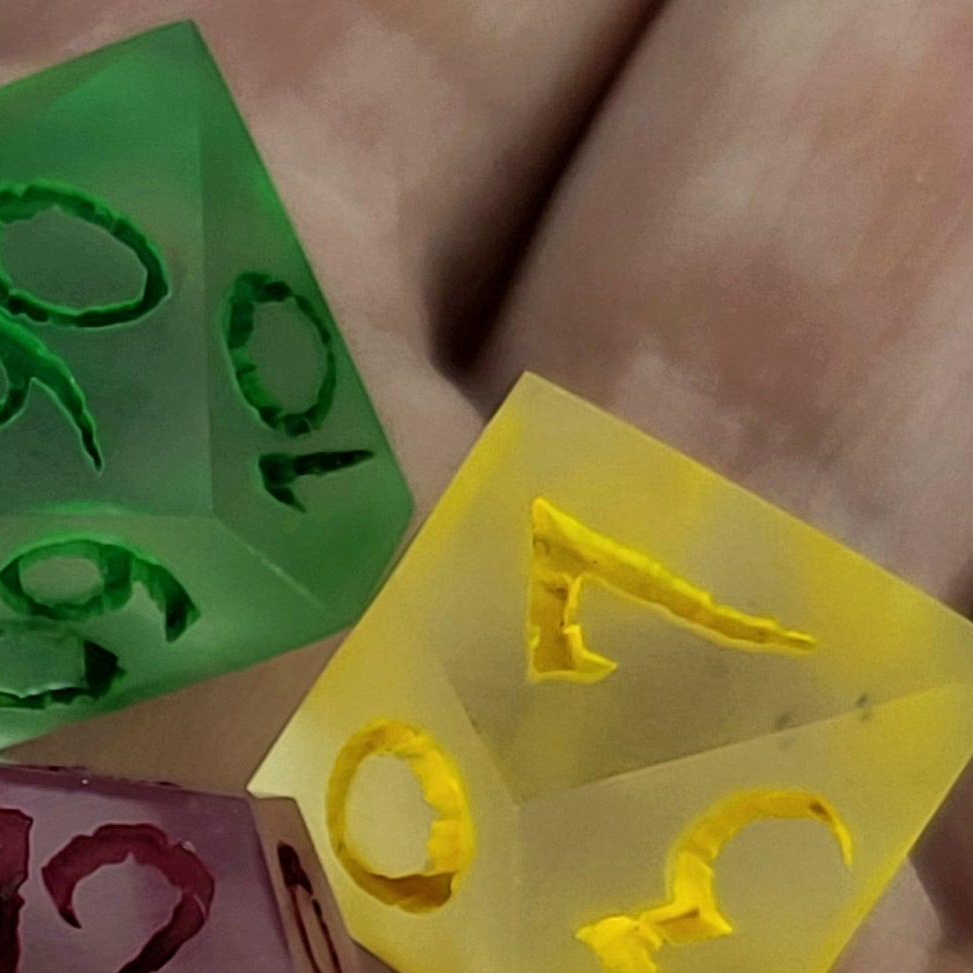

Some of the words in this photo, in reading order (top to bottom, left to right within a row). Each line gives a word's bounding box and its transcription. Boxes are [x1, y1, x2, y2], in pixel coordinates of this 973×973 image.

[224, 271, 374, 512] 10
[527, 498, 817, 683] 7
[327, 718, 473, 914] 0
